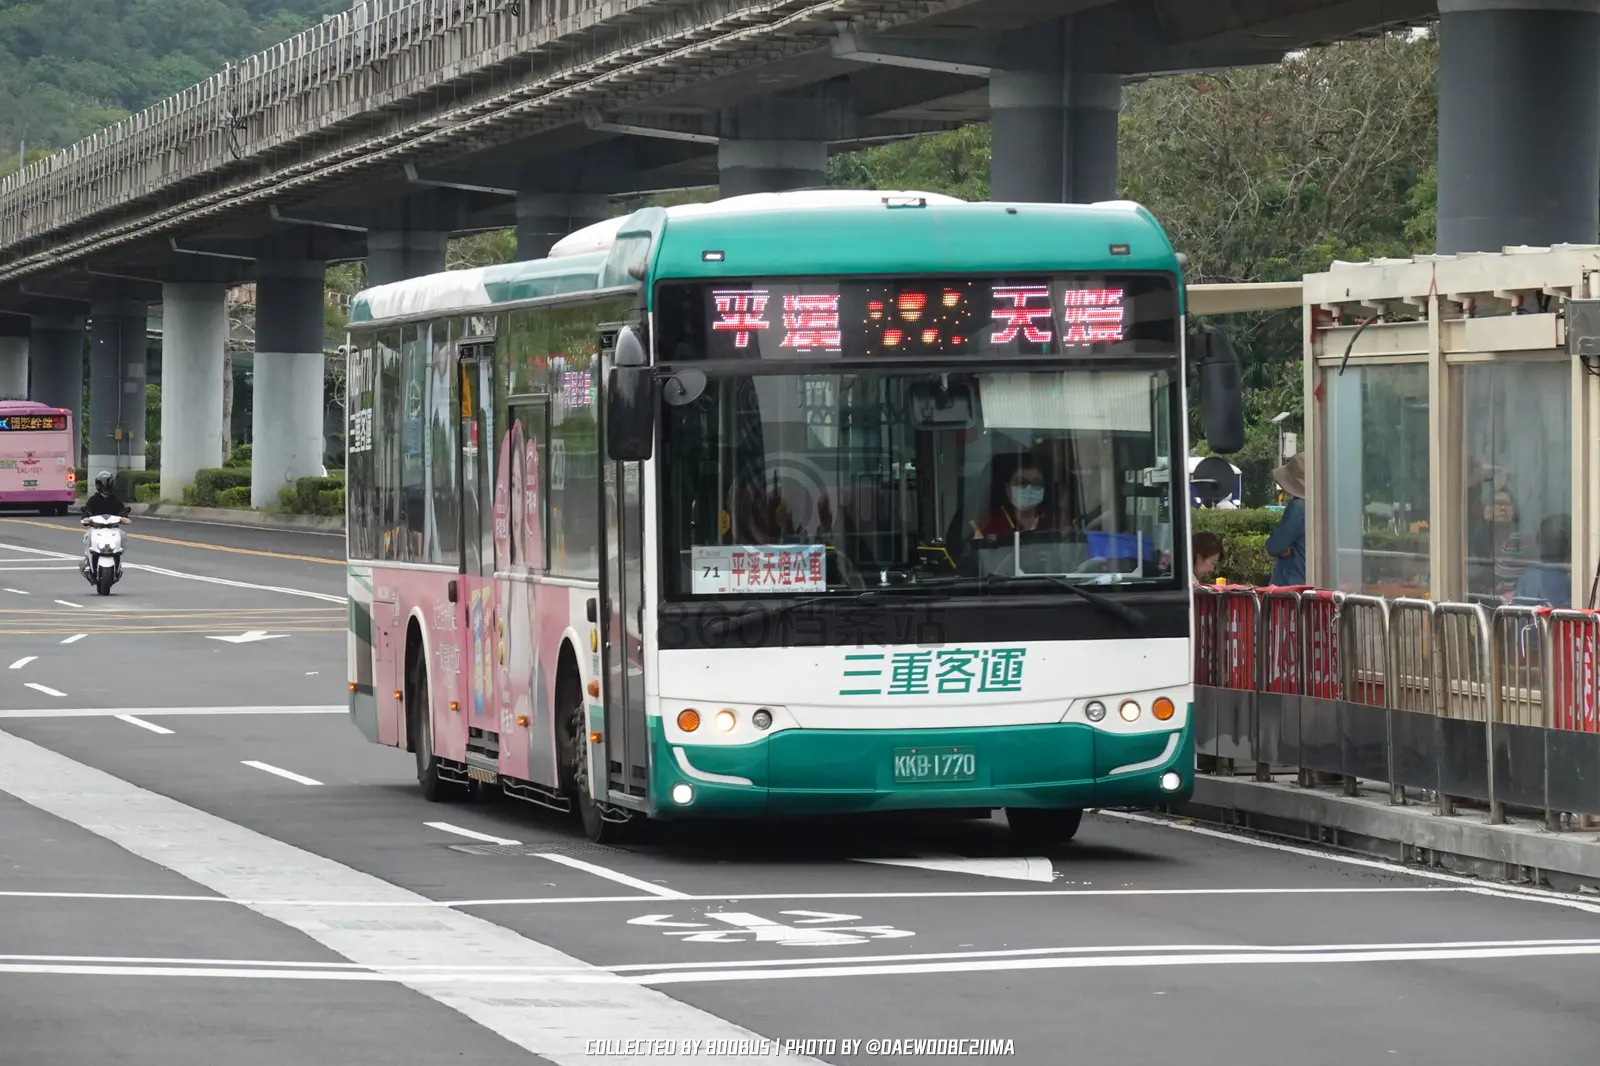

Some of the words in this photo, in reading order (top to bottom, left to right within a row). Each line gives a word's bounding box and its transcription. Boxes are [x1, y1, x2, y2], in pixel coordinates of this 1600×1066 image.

[702, 566, 721, 578] 71
[731, 551, 823, 586] 平溪天燈公車
[839, 647, 1027, 696] 三重客運
[895, 753, 975, 777] KKB-1770
